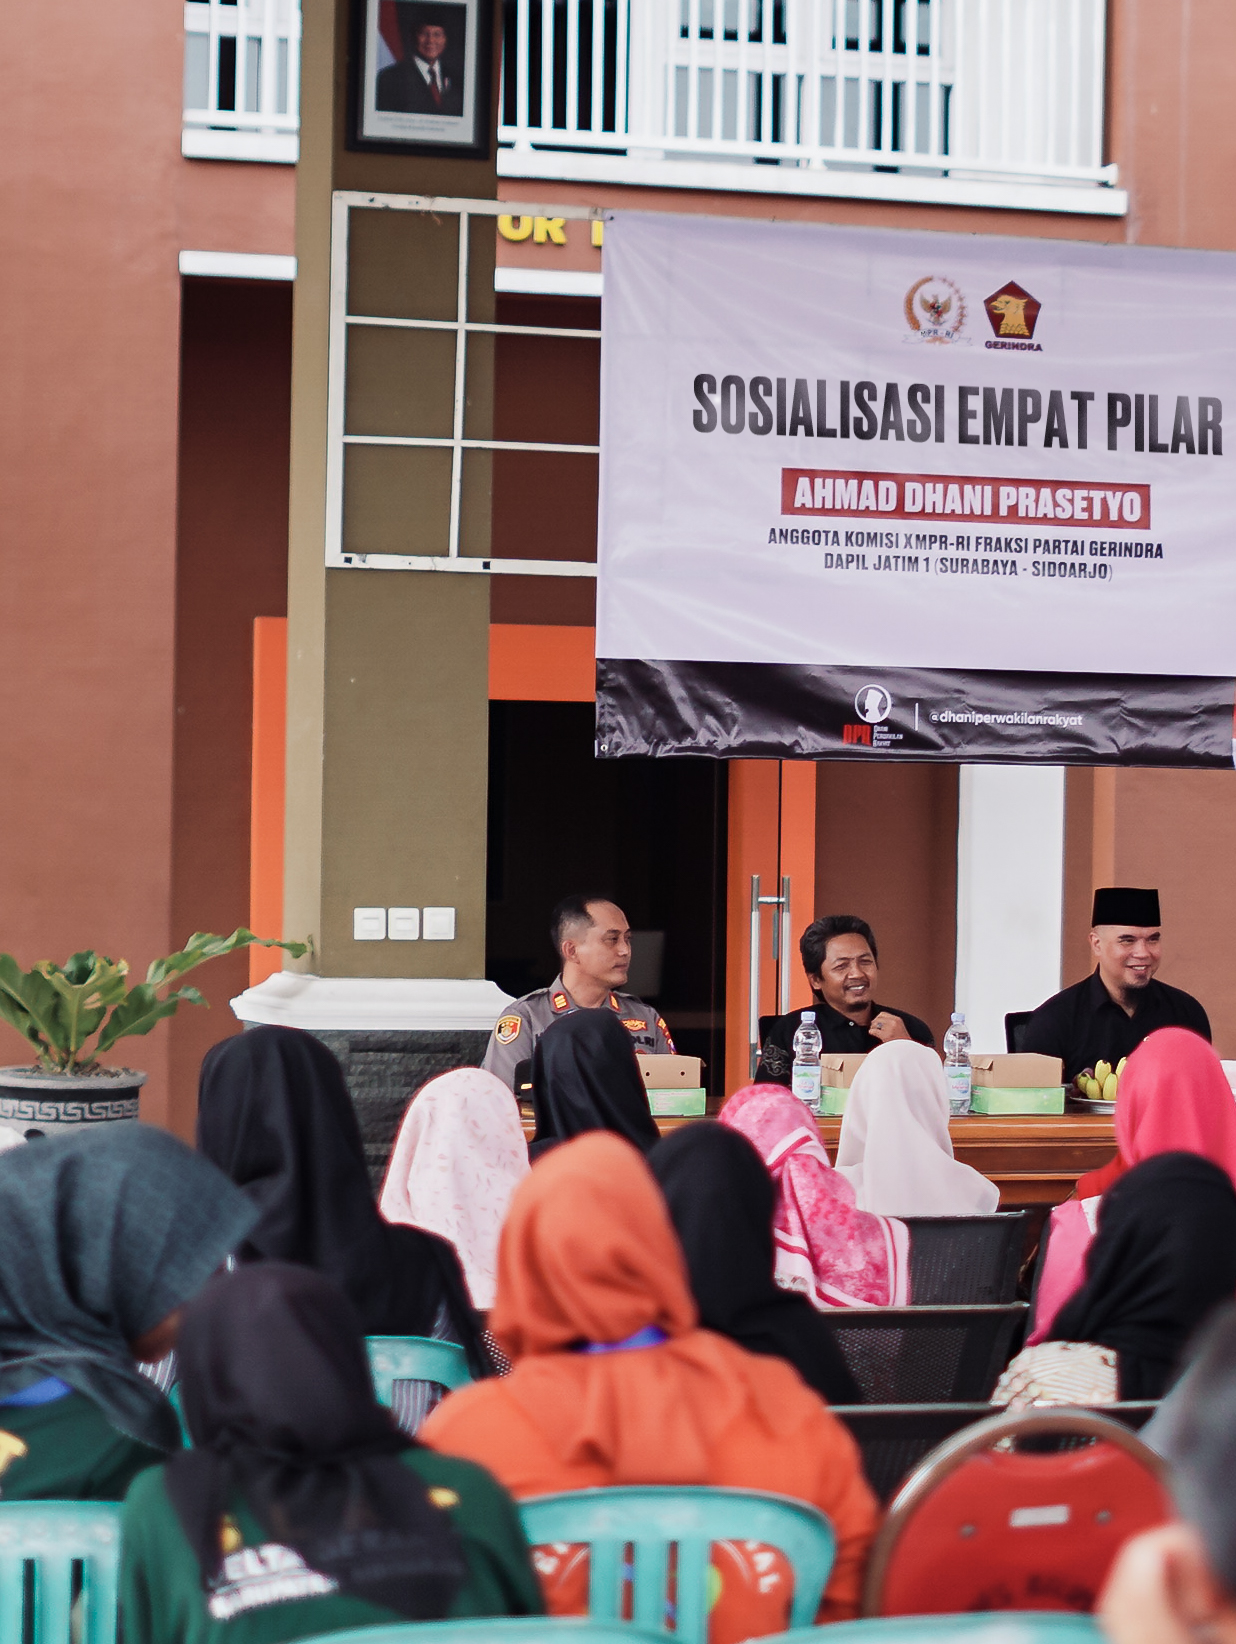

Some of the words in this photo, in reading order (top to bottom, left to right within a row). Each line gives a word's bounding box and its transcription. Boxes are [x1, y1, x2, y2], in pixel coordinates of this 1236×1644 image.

[984, 340, 1044, 352] GERINDRA
[692, 373, 945, 444] SOSIALISASI
[958, 385, 1095, 450] EMPAT
[1107, 392, 1223, 456] PILAR
[793, 476, 898, 513] AHMAD
[904, 481, 992, 516] DHANI
[999, 486, 1142, 523] PRASETYO
[767, 527, 841, 547] ANGGOTA
[844, 530, 900, 549] KOMISI
[975, 536, 1029, 554] FRAKSI
[1033, 538, 1085, 556] PARTAI
[1089, 541, 1164, 559] GERINDRA
[824, 553, 869, 571] DAPIL
[873, 554, 919, 573] JATIM
[922, 556, 930, 573] 1
[933, 557, 1019, 576] (SURABAYA
[1031, 560, 1113, 583] SIDOARJO)
[928, 710, 1083, 729] @dhaniperwakilanrakyat
[630, 1034, 655, 1048] OLRI
